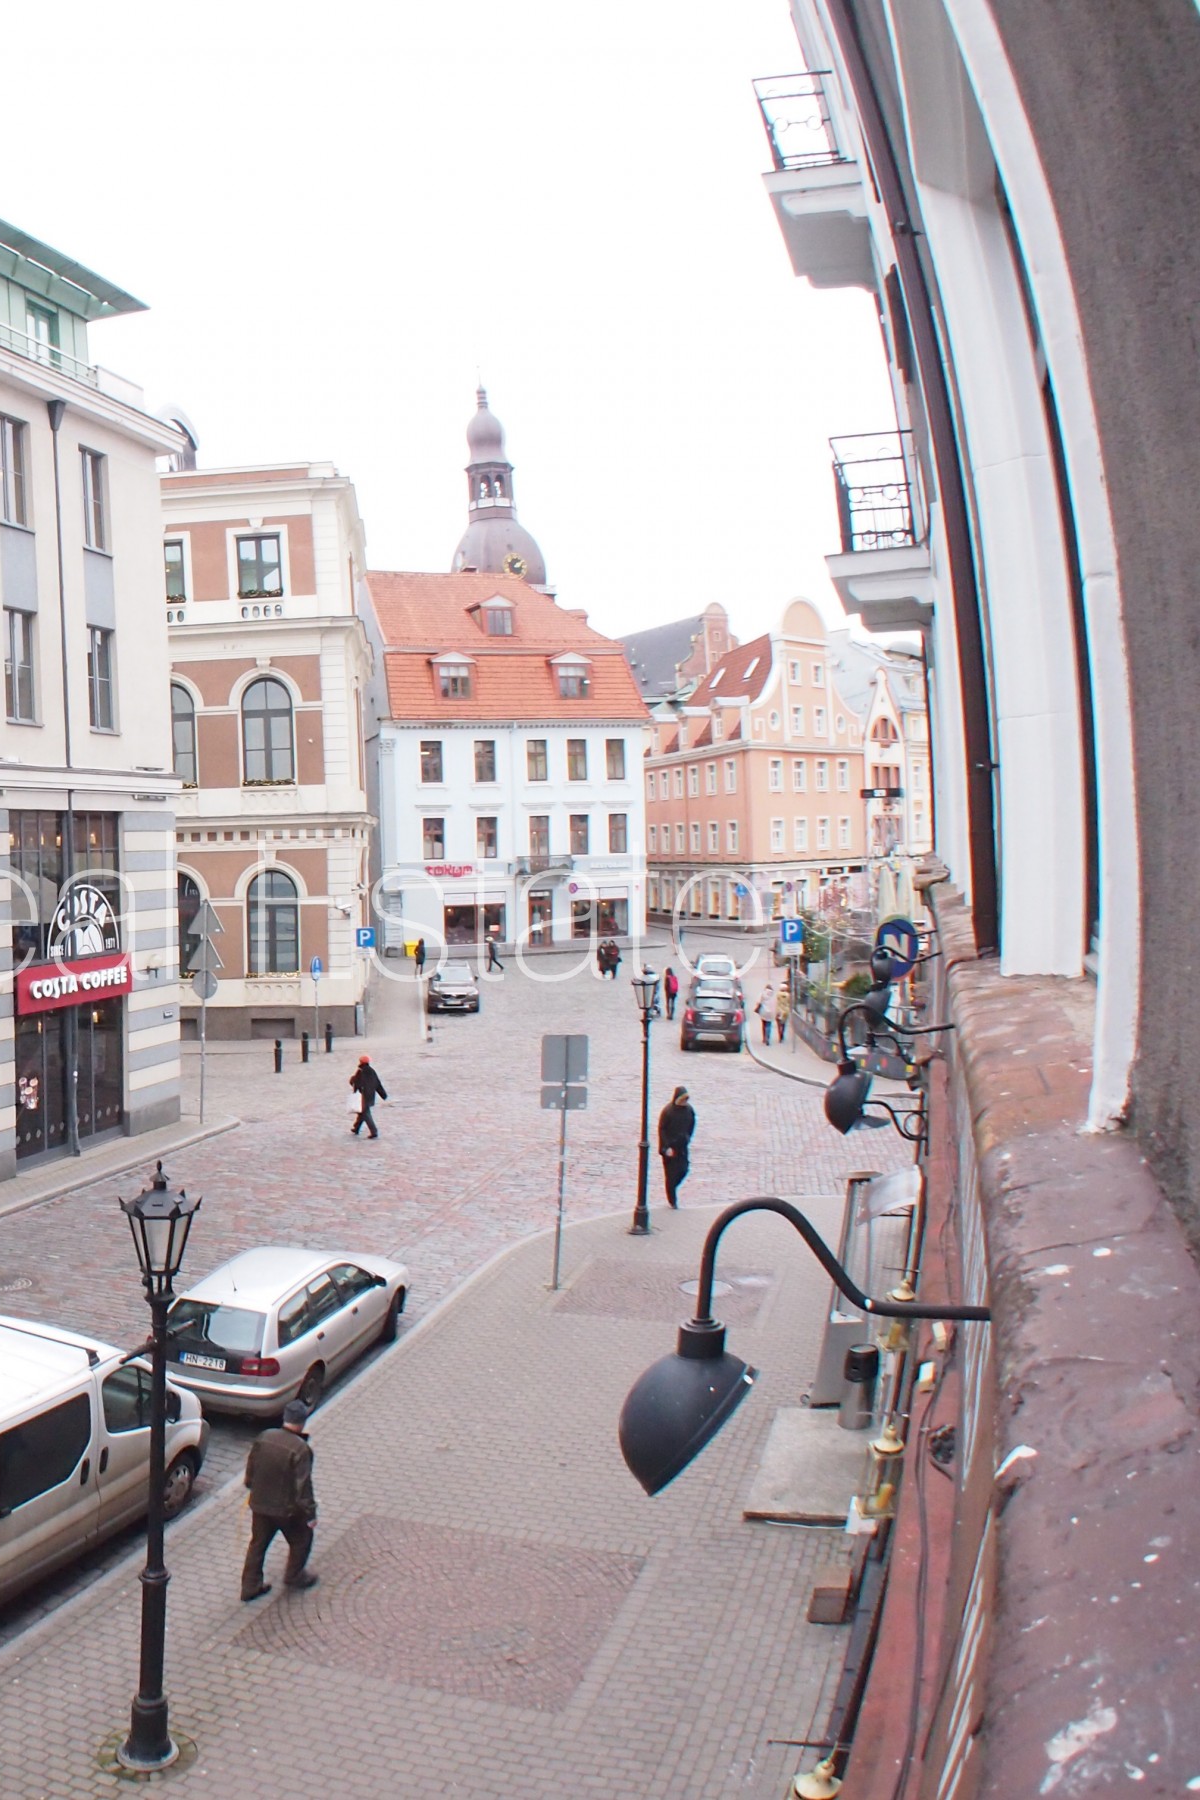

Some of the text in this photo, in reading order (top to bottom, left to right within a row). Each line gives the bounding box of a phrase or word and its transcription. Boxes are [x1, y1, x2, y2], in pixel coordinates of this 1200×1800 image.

[360, 929, 371, 945] P
[785, 921, 799, 940] P
[30, 966, 127, 999] COSTA COFFEE
